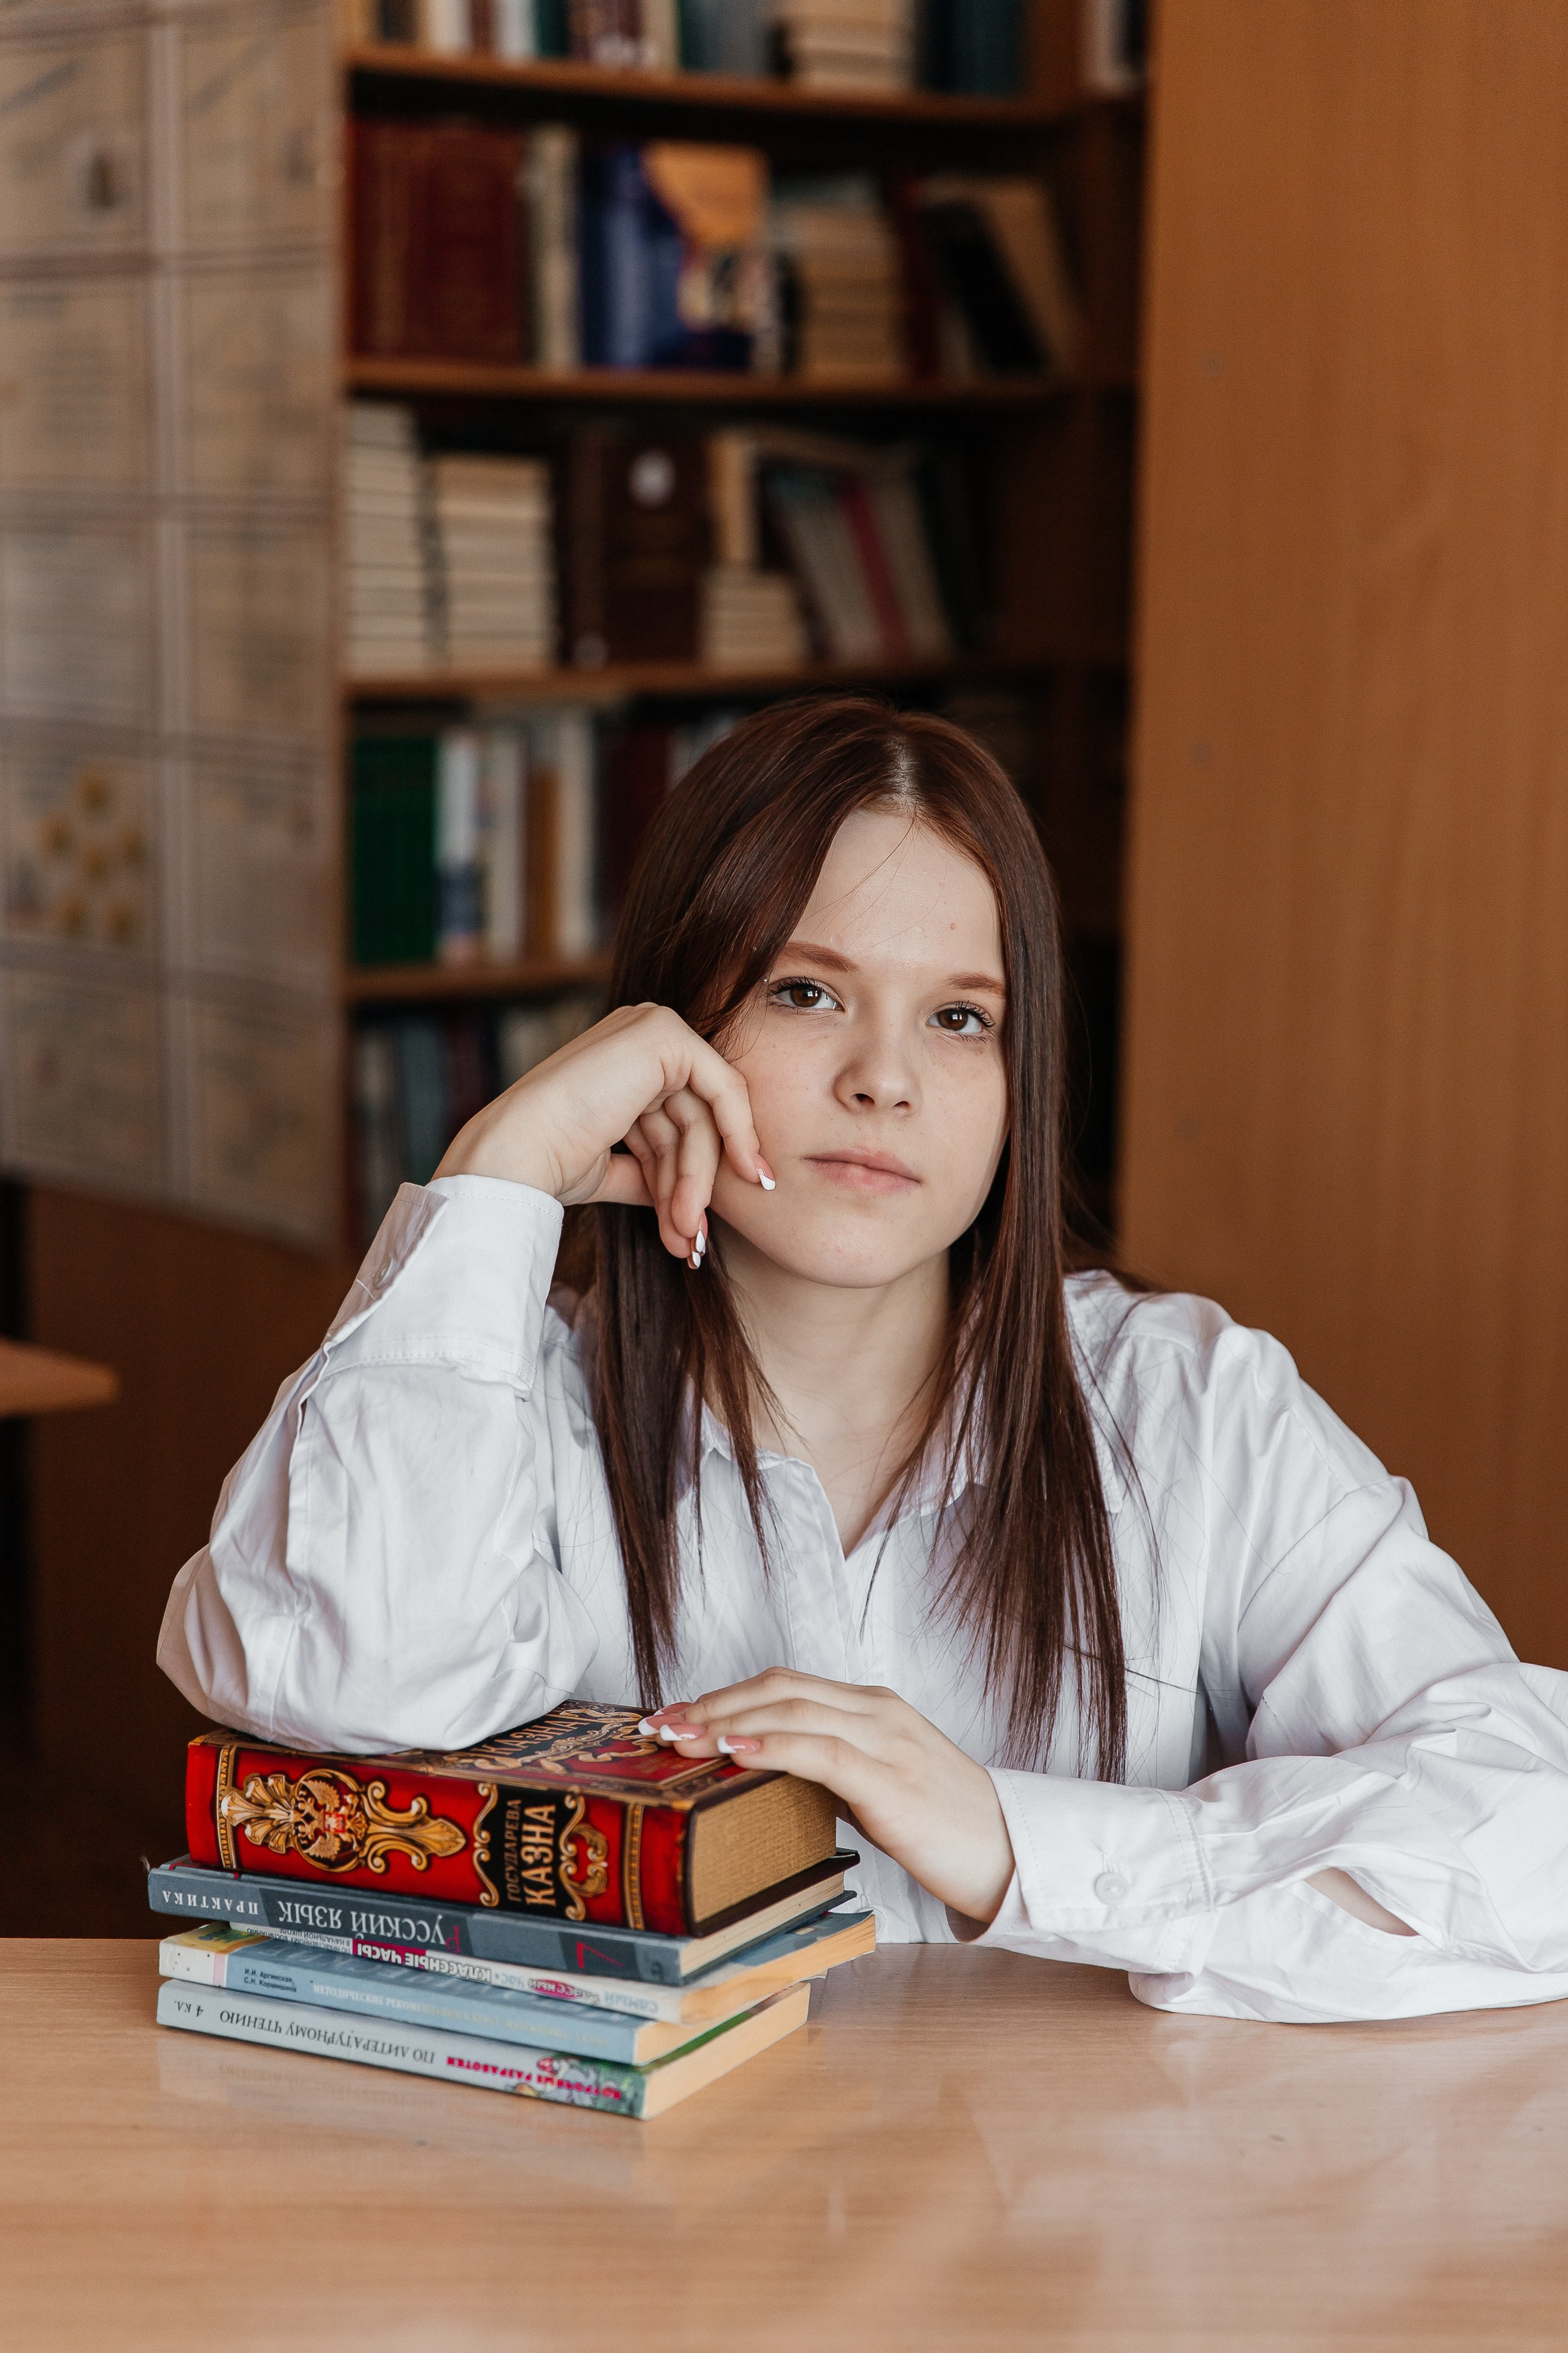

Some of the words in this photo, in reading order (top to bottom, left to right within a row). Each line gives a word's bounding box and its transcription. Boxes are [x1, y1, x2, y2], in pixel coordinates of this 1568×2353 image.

[472, 1720, 591, 1755] КАЗНА
[504, 1799, 522, 1902] ГОСУДАРЕВА
[520, 1804, 557, 1907] КАЗНА
[162, 1890, 259, 1915] ПРАКТИКА
[357, 1943, 402, 1964] ЧАСЫ
[577, 1941, 624, 1969] 7
[405, 1952, 492, 1983] КЛАССНЫЕ
[196, 2005, 204, 2018] 4
[220, 2011, 282, 2034] ЧТЕНИЮ
[286, 2022, 409, 2059] ЛИТЕРАТУРНОМУ
[413, 2048, 436, 2065] ПО
[446, 2056, 532, 2083] РАЗРАБОТКИ
